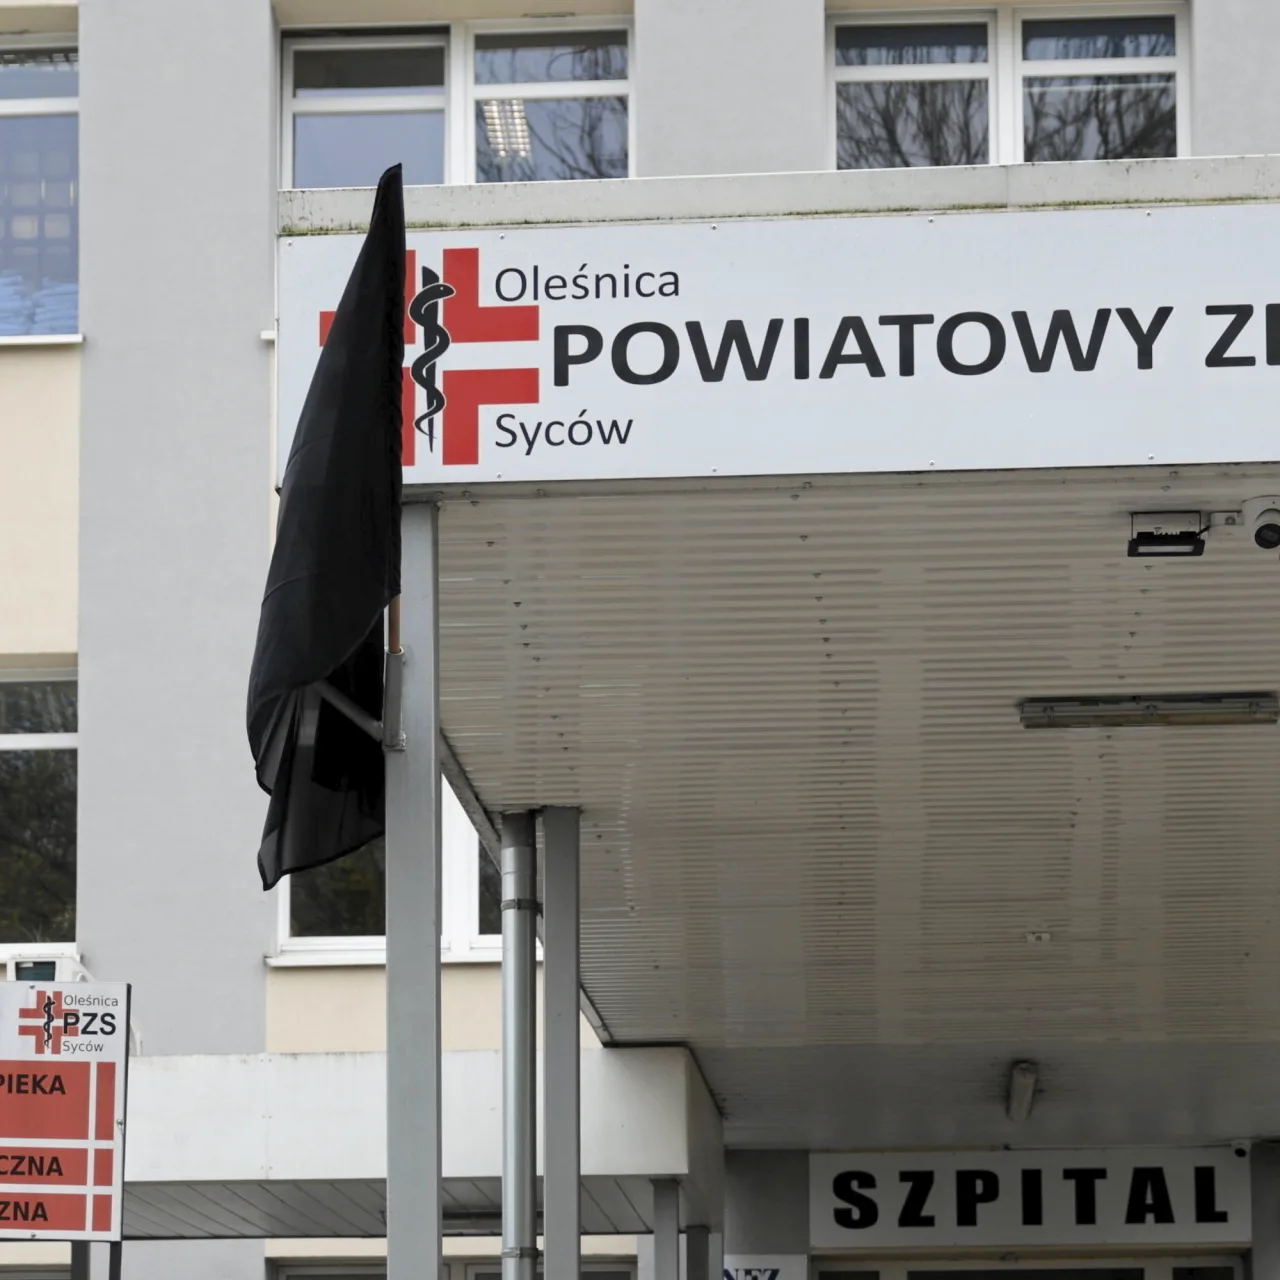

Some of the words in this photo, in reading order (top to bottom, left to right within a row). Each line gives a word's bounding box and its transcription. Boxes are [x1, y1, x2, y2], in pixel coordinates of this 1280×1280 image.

[495, 263, 680, 302] Oleśnica
[553, 306, 1174, 387] POWIATOWY
[495, 412, 634, 456] Syców
[63, 993, 119, 1009] Oleśnica
[62, 1012, 117, 1036] PZS
[61, 1039, 104, 1055] Syców
[832, 1165, 1230, 1230] SZPITAL
